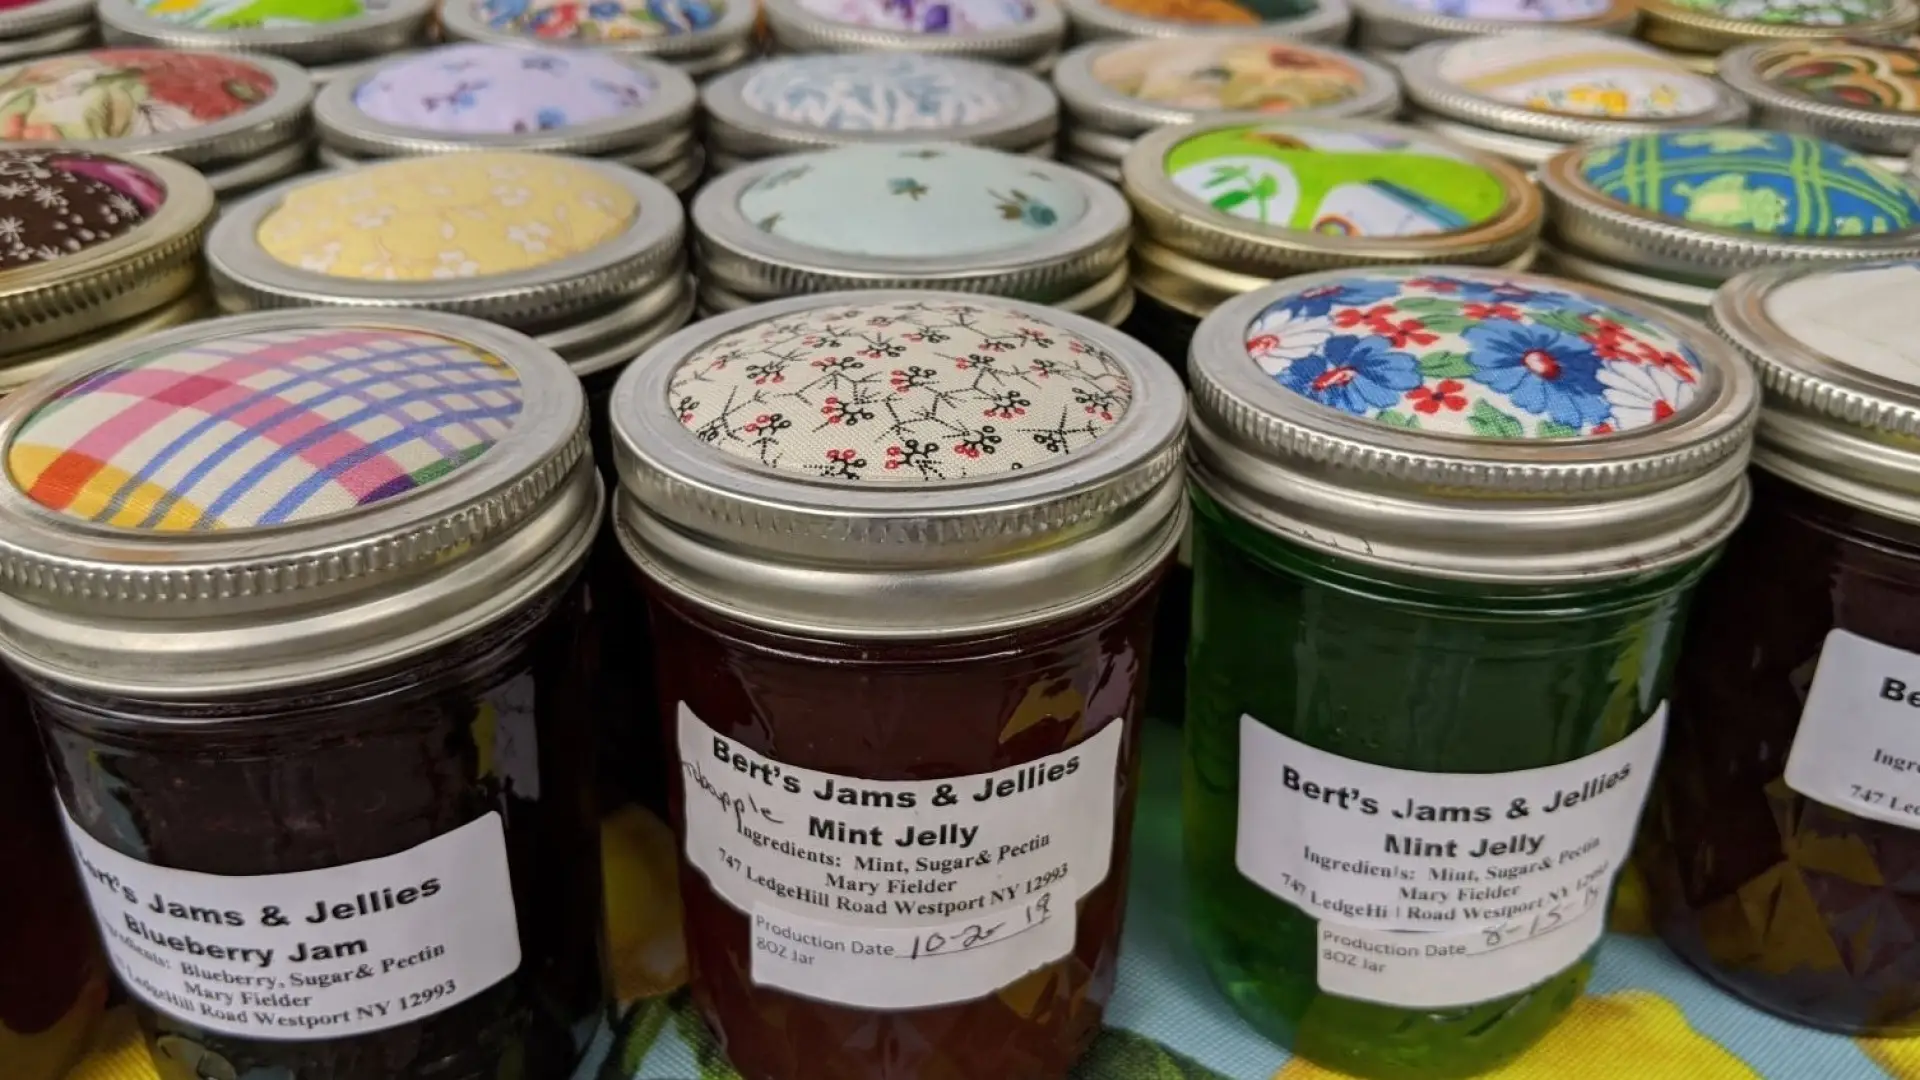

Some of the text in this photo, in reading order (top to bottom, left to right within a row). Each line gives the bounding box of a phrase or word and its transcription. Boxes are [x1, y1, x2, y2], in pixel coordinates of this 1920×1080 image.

[713, 735, 1080, 809] Bert's Jams & Jellies
[1282, 762, 1632, 822] Bert's Jams & Jellies
[1850, 783, 1884, 805] 747
[737, 825, 1050, 874] Ingredients: Mint, Sugar& Pectin
[808, 815, 979, 849] Mint Jelly
[1384, 833, 1545, 859] Mint Jelly
[719, 847, 1068, 918] 747 LedgeHill Road Westport NY 12993
[826, 872, 957, 896] Mary Fielder
[1428, 868, 1479, 882] Mint,
[1485, 857, 1553, 880] Sugar&
[148, 893, 246, 926] Jams
[260, 905, 291, 927] &
[305, 877, 442, 924] Jellies
[1280, 872, 1306, 896] 747
[1407, 906, 1456, 920] Road
[1462, 898, 1543, 920] Westport
[1399, 884, 1521, 904] Mary Fielder
[123, 911, 273, 968] Blueberry
[288, 938, 368, 962] Jam
[756, 914, 845, 952] Production
[1323, 930, 1419, 957] Production
[181, 961, 285, 989] Blueberry,
[290, 963, 374, 988] Sugar&
[381, 943, 446, 974] Pectin
[183, 981, 313, 1008] Mary Fielder
[201, 1003, 249, 1024] Road
[253, 1010, 350, 1030] Westport
[356, 1001, 391, 1020] NY
[400, 978, 457, 1011] 12993
